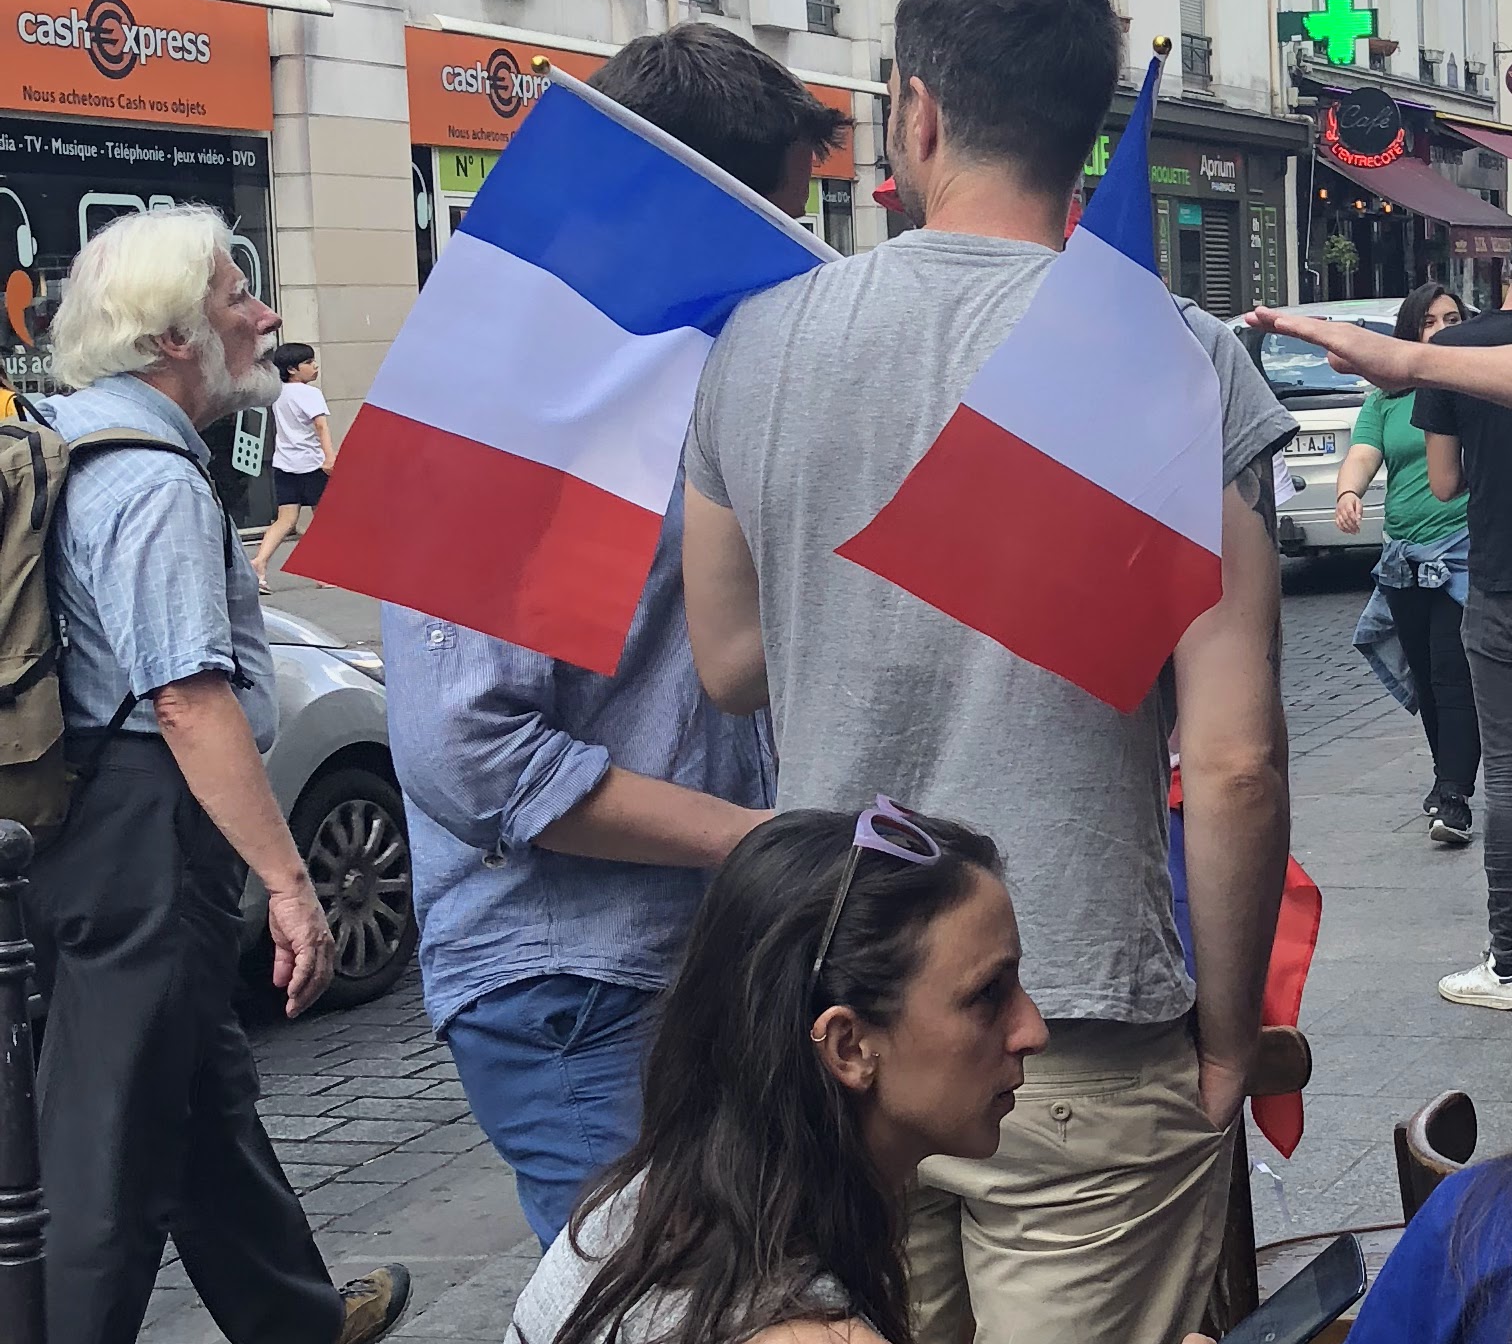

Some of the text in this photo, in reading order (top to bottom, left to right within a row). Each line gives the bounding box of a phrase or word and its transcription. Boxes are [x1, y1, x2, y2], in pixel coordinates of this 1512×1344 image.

[23, 85, 207, 117] Nous achetons Cash vos objets
[448, 125, 470, 140] Nous
[472, 128, 509, 143] achetons
[1340, 104, 1394, 135] Café
[24, 135, 42, 153] TV
[51, 138, 98, 161] Musique
[105, 141, 165, 164] Téléphonie
[173, 147, 195, 166] Jeux
[198, 149, 225, 165] vidéo
[232, 151, 256, 166] DVD
[1200, 155, 1236, 181] Aprium
